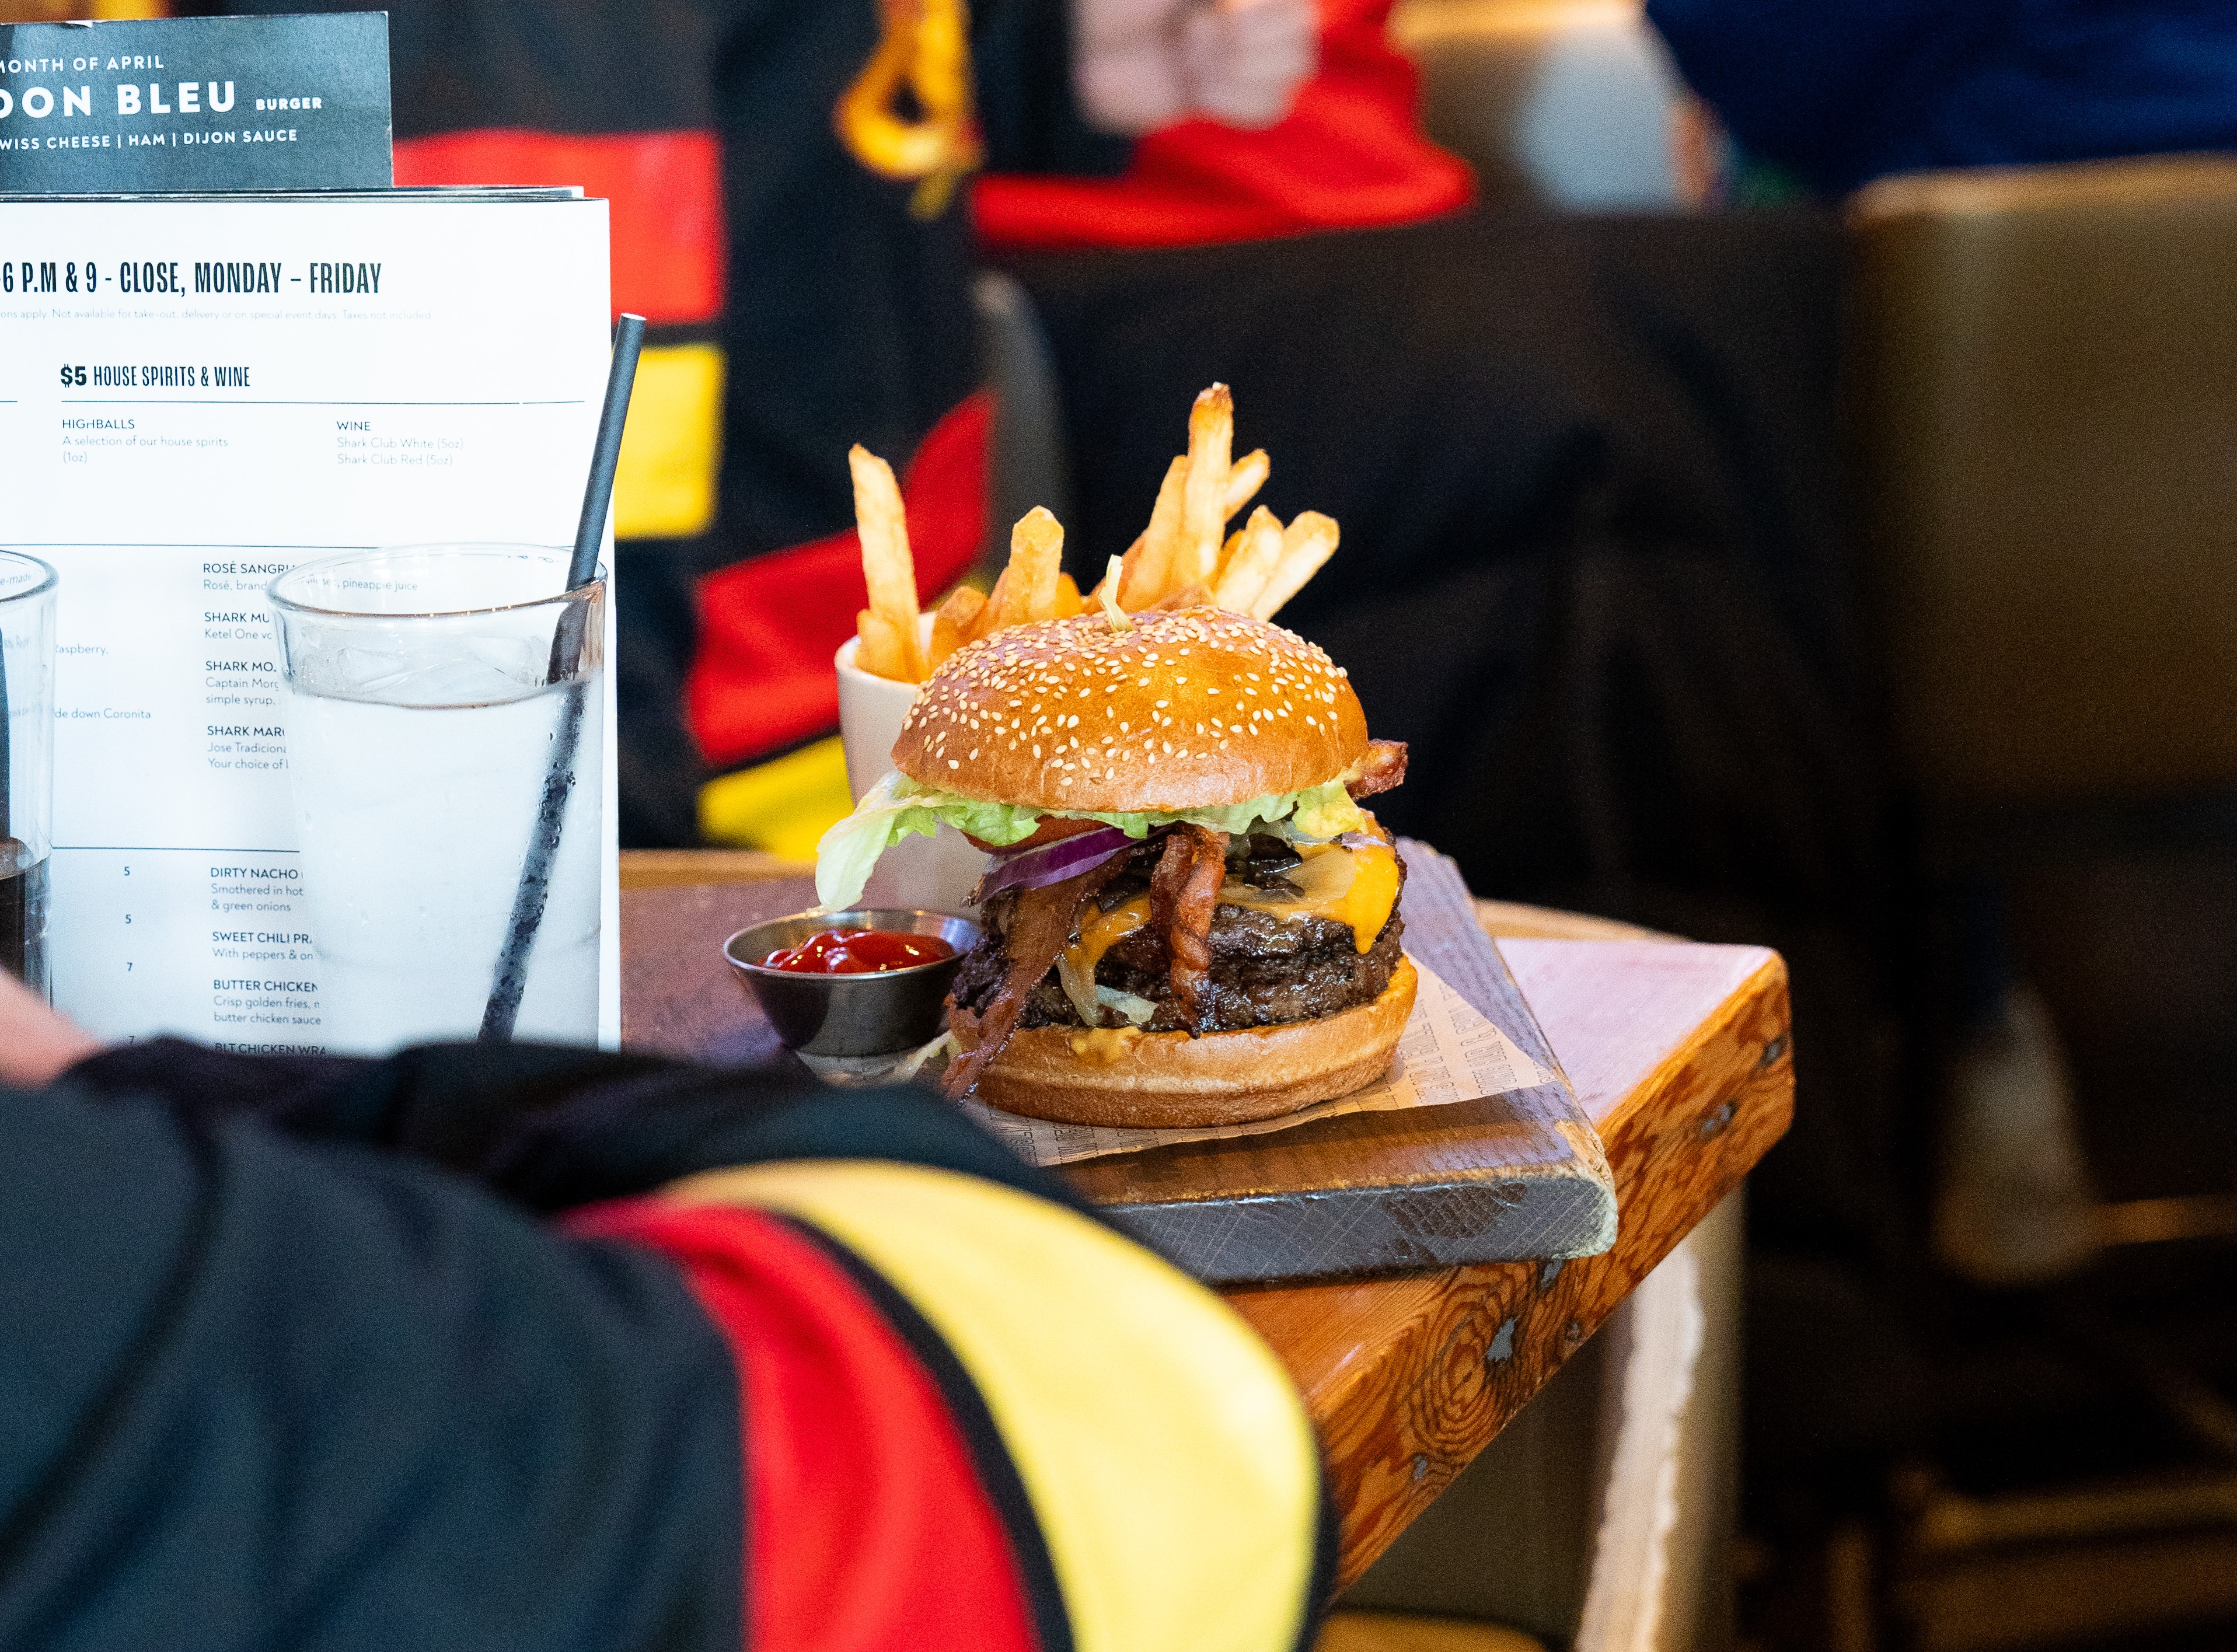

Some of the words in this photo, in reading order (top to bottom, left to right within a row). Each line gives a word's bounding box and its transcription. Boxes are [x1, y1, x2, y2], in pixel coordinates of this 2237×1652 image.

[74, 57, 98, 71] OF
[107, 55, 163, 70] APRIL
[117, 81, 234, 115] BLEU
[256, 97, 322, 110] BURGER
[47, 135, 110, 149] CHEESE
[129, 134, 165, 146] HAM
[184, 132, 235, 144] DIJON
[243, 130, 296, 142] SAUCE
[22, 263, 56, 292] P.M
[66, 262, 78, 292] &
[86, 262, 96, 292] 9
[120, 261, 186, 297] CLOSE,
[196, 262, 282, 292] MONDAY
[310, 262, 382, 293] FRIDAY
[53, 310, 71, 318] Not
[75, 309, 115, 318] available
[118, 309, 131, 319] for
[182, 310, 219, 320] delivery
[250, 310, 282, 320] special
[343, 310, 367, 320] Taxes
[371, 310, 386, 319] not
[60, 364, 87, 388] $5
[94, 365, 138, 386] HOUSE
[142, 366, 196, 386] SPIRITS
[201, 366, 209, 386] &
[215, 366, 250, 386] WINE
[62, 419, 135, 429] HIGHBALLS
[337, 421, 371, 431] WINE
[62, 436, 71, 445] A
[75, 435, 122, 445] selection
[126, 435, 137, 445] of
[161, 436, 192, 446] house
[196, 436, 228, 449] spirits
[337, 438, 367, 448] Shark
[371, 438, 396, 448] Club
[400, 438, 433, 448] White
[438, 438, 463, 450] (5oz)
[63, 451, 87, 463] (1oz)
[337, 454, 367, 464] Shark
[371, 454, 397, 464] Club
[402, 454, 422, 464] Red
[427, 454, 452, 467] (5oz)
[203, 561, 236, 573] ROSÉ
[240, 564, 295, 574] SANGRI
[205, 612, 246, 623] SHARK
[205, 629, 231, 638] Ketel
[235, 628, 258, 639] One
[206, 661, 247, 671] SHARK
[206, 677, 247, 689] Captain
[206, 694, 240, 705] simple
[72, 708, 100, 718] down
[103, 708, 151, 718] Coronita
[208, 726, 250, 736] SHARK
[208, 743, 232, 752] Jose
[208, 758, 231, 768] Your
[235, 759, 268, 769] choice
[272, 759, 283, 769] of
[124, 867, 130, 875] 5
[211, 868, 247, 877] DIRTY
[251, 869, 298, 879] NACHO
[212, 883, 270, 895] Smothered
[273, 886, 282, 895] in
[211, 899, 219, 910] &
[223, 903, 253, 912] green
[256, 902, 291, 911] onions
[125, 914, 131, 924] 5
[213, 931, 254, 942] SWEET
[257, 932, 289, 943] CHILI
[294, 934, 312, 944] PR
[212, 948, 238, 958] With
[242, 951, 285, 961] peppers
[289, 950, 296, 959] &
[127, 962, 132, 972] 7
[214, 980, 260, 990] BUTTER
[214, 996, 242, 1008] Crisp
[246, 997, 282, 1009] golden
[214, 1012, 247, 1022] butter
[250, 1012, 288, 1024] chicken
[239, 1044, 295, 1054] CHICKEN
